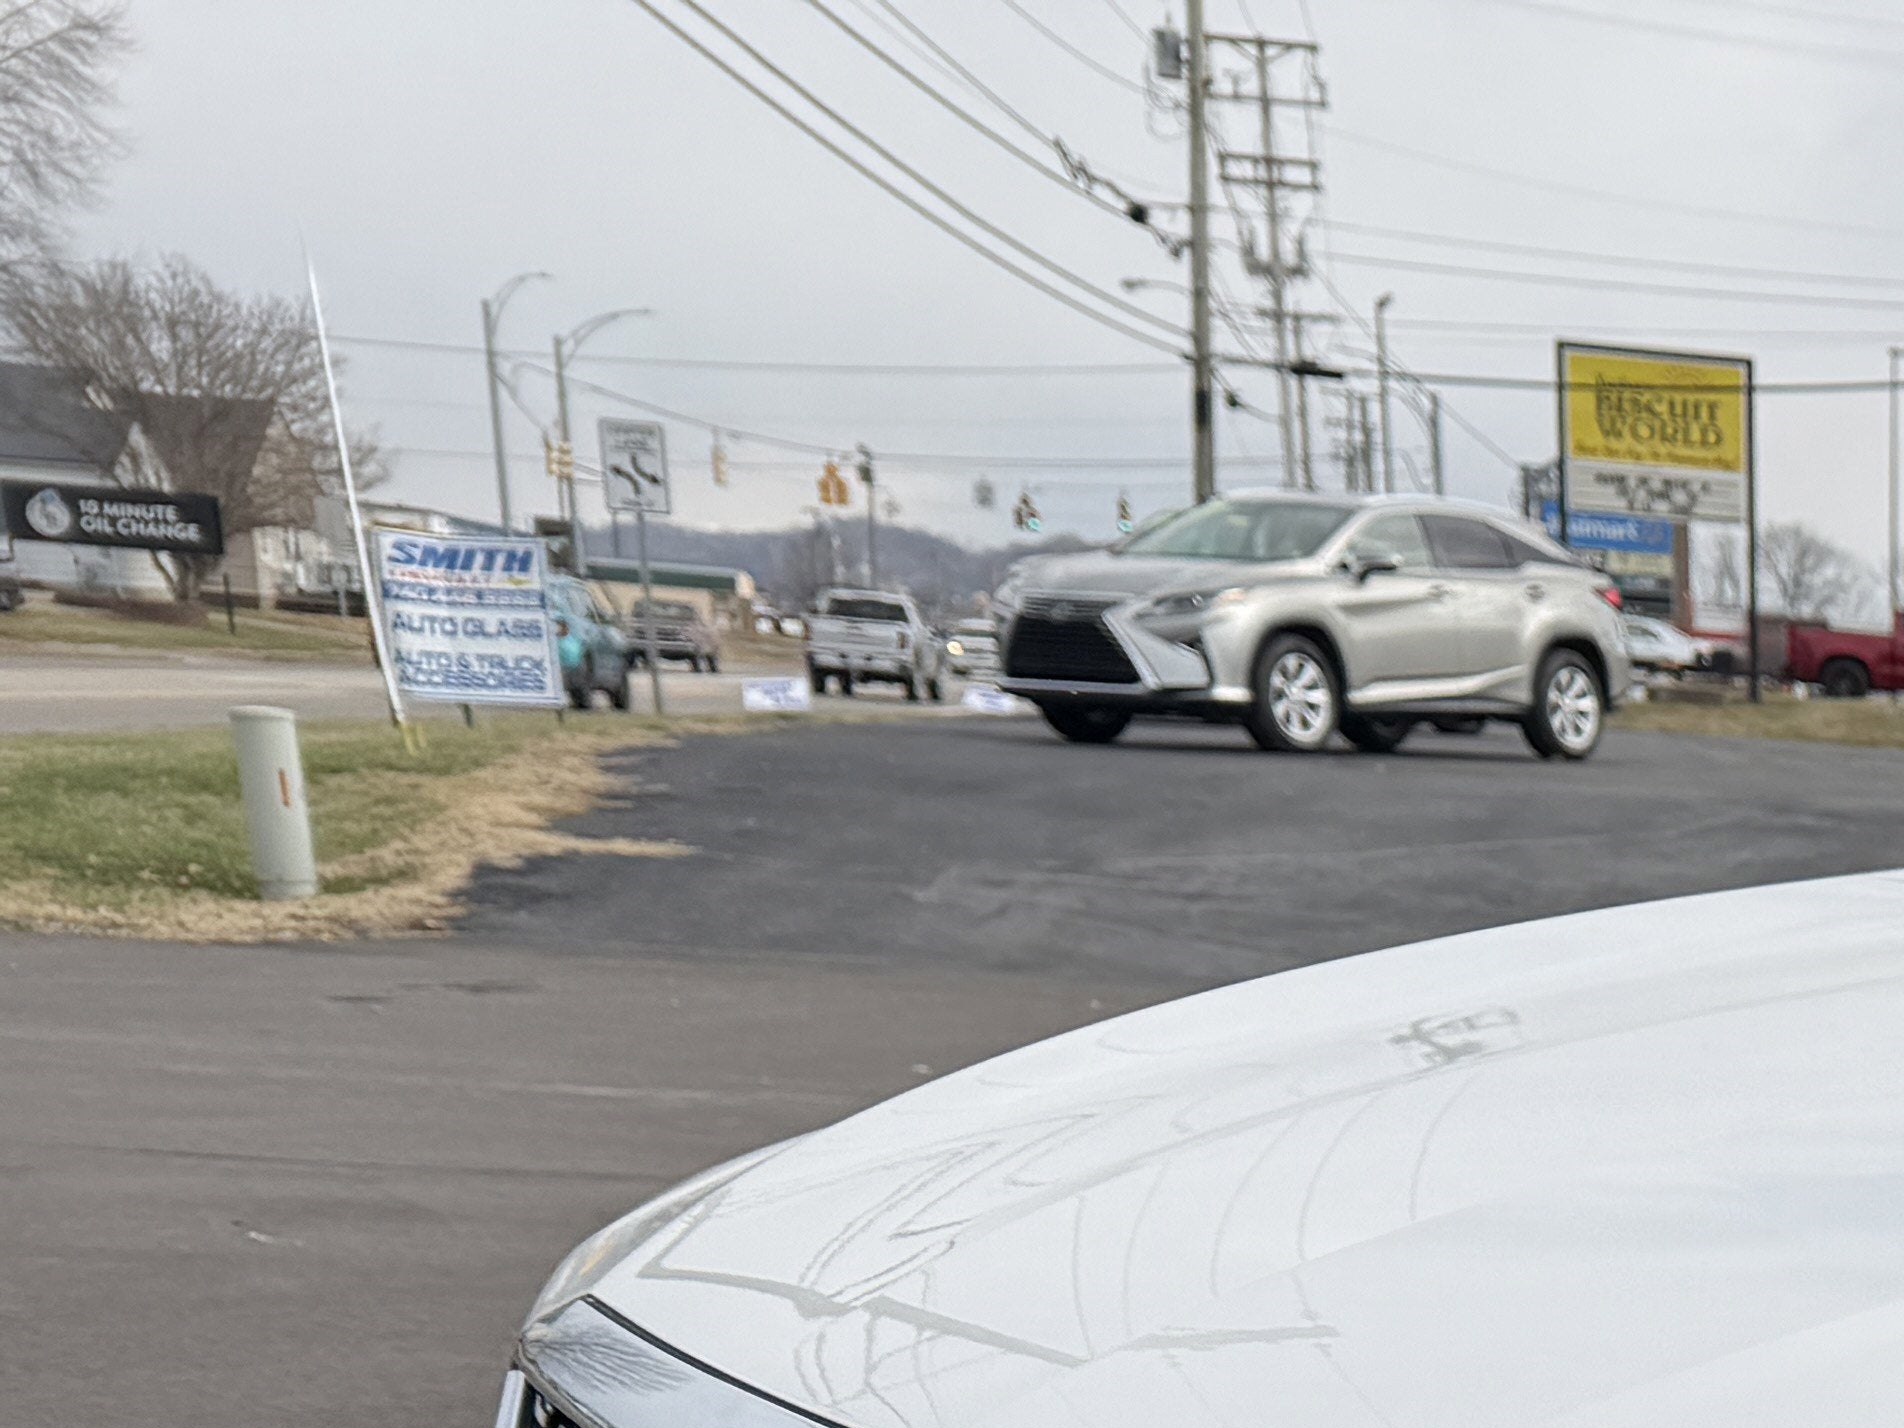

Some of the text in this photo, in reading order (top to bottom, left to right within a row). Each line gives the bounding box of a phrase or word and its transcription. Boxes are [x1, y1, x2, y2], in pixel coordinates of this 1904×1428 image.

[103, 500, 179, 522] MINUTE
[80, 515, 200, 542] OIL CHANGE
[388, 540, 534, 573] SMITH
[392, 612, 458, 636] AUTO
